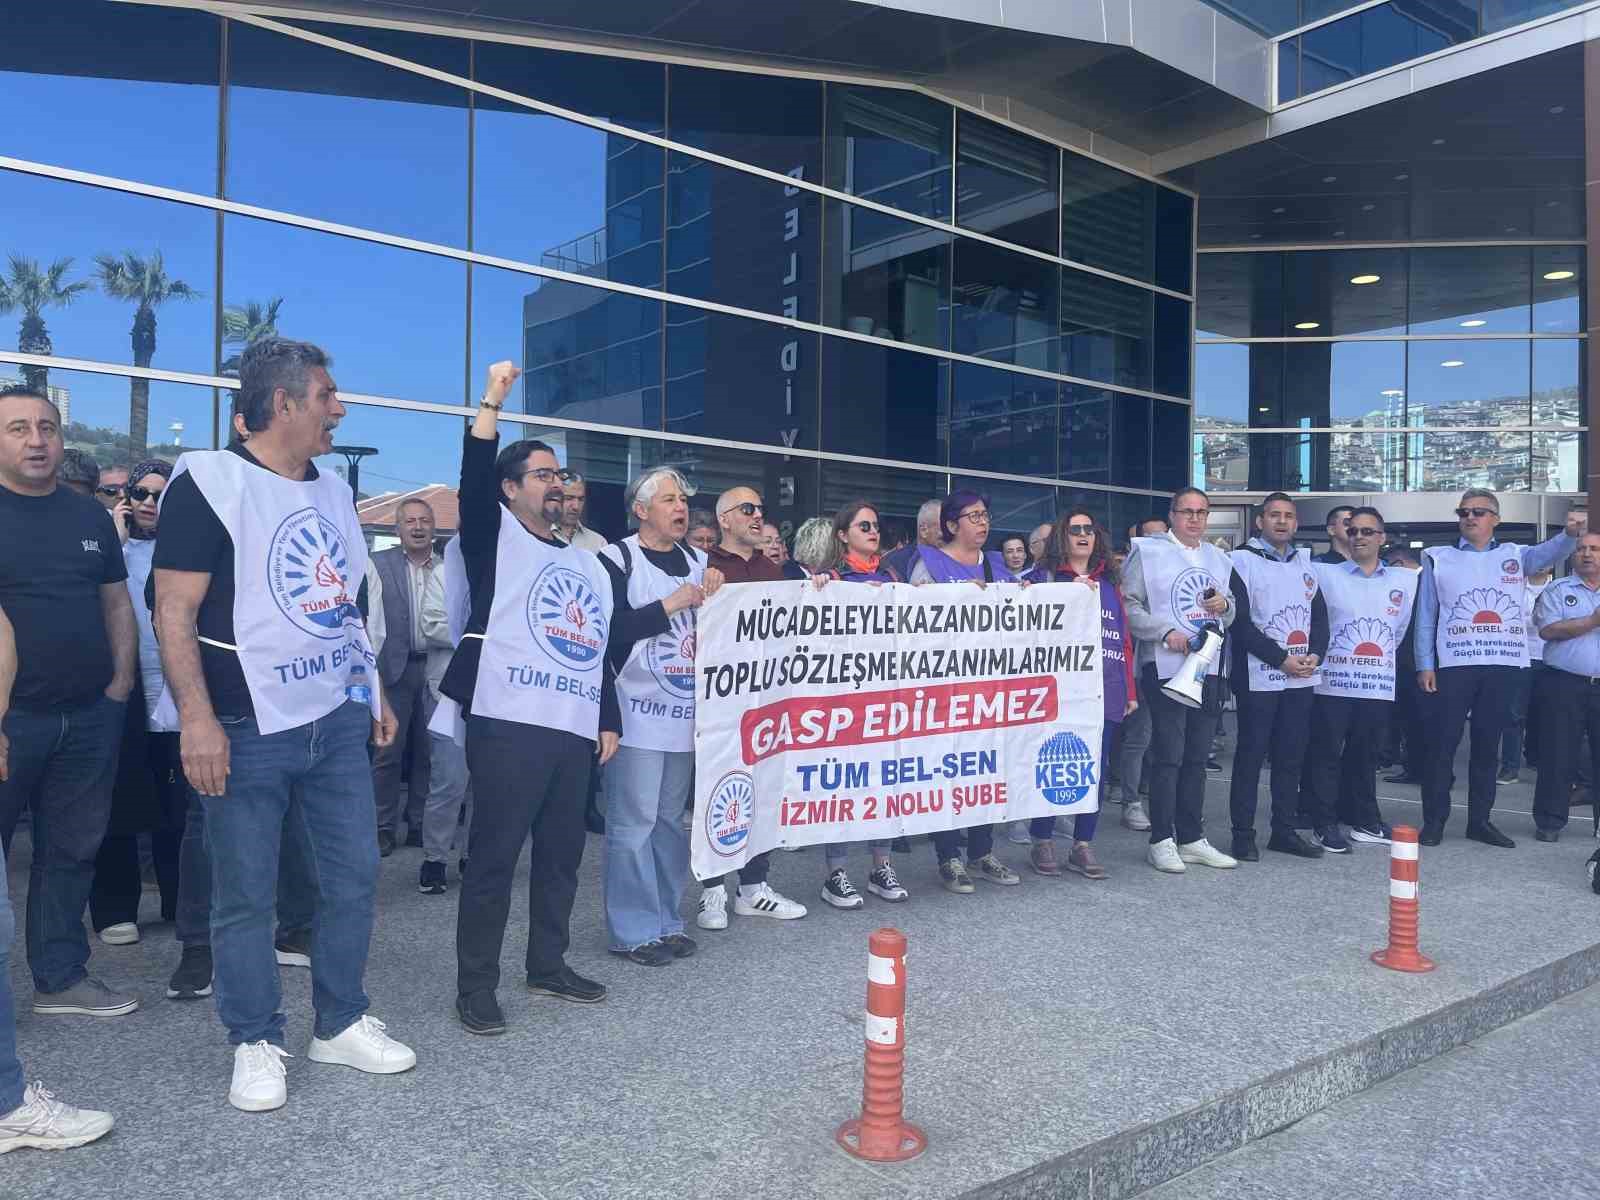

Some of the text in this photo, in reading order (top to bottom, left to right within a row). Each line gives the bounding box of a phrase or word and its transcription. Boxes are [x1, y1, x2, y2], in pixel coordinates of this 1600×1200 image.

[897, 598, 1065, 634] KAZANDIĞIMIZ
[1101, 608, 1115, 620] UL
[1471, 625, 1502, 633] YEREL
[273, 656, 325, 684] TÜM
[507, 664, 601, 705] TÜM BEL-SE
[704, 645, 1095, 699] TOPLU SÖZLEŞME KAZANIMLARIMIZ
[630, 698, 667, 717] TÜM
[751, 686, 1049, 757] GASP EDİLEMEZ
[797, 750, 997, 792] TÜM BEL-SEN
[1035, 761, 1097, 789] KESK
[781, 794, 855, 827] İZMİR
[862, 796, 878, 821] 2
[886, 789, 944, 819] NOLU
[952, 783, 1008, 816] ŞUBE
[1054, 789, 1077, 802] 1995
